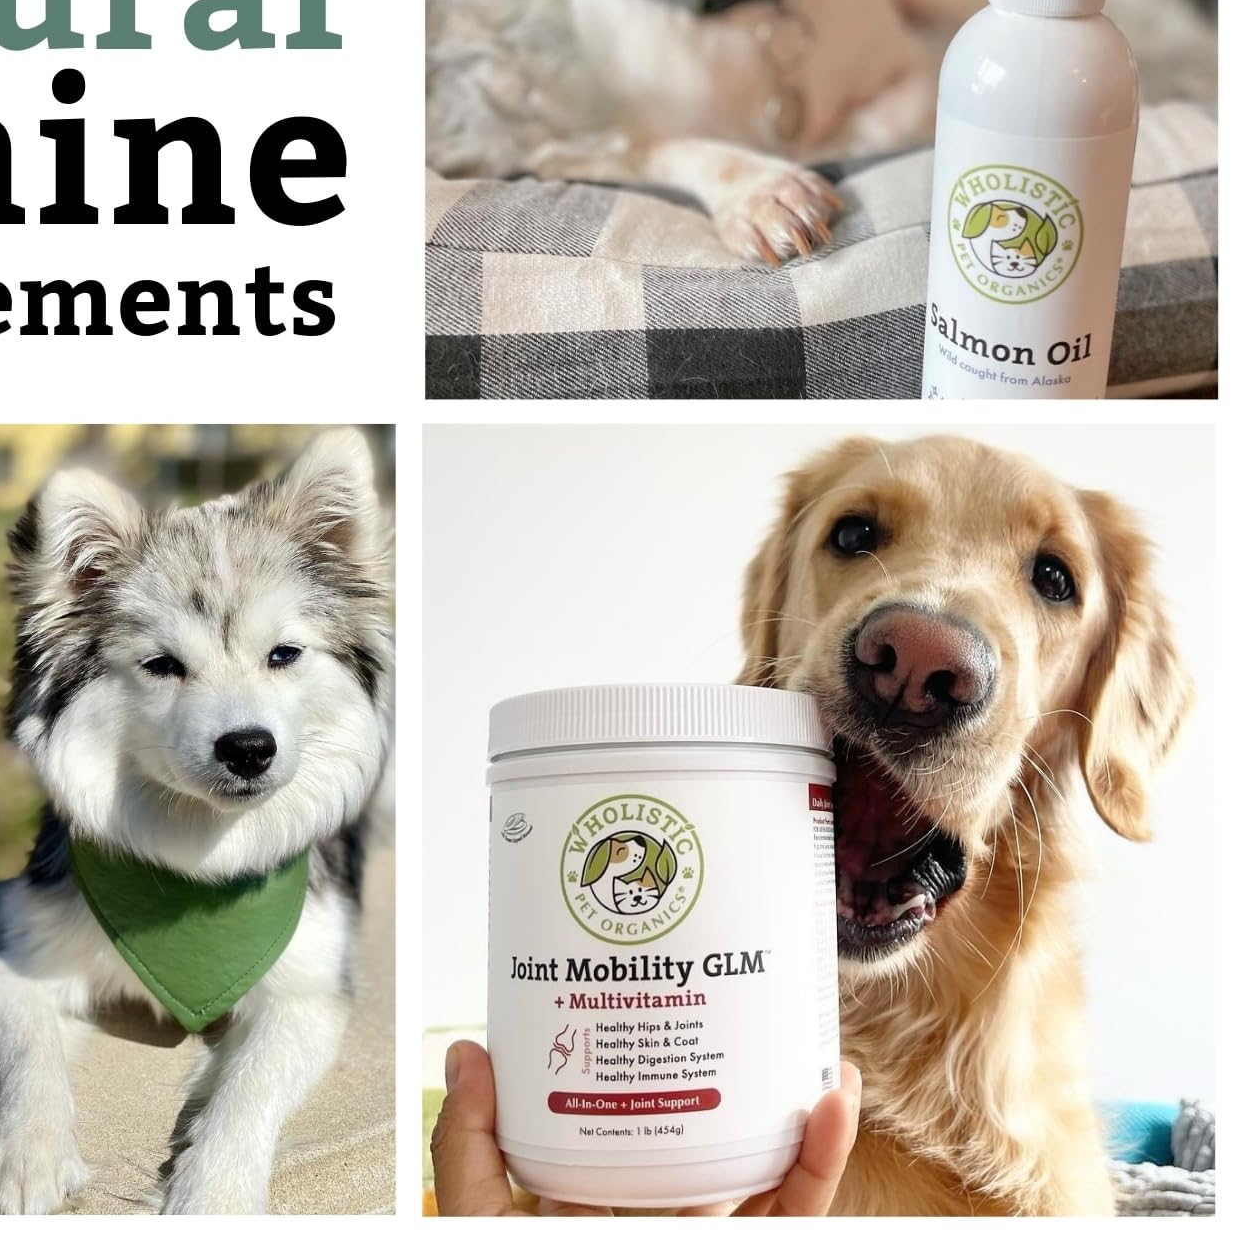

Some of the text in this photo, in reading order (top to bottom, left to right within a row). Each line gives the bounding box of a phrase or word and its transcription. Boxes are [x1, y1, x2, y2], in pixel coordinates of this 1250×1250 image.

[955, 173, 1076, 229] WHOLISTIC
[957, 242, 975, 270] PET
[931, 303, 1091, 365] Salmon Oil
[938, 343, 1071, 386] Wild caught from Alaska
[568, 803, 692, 856] WHOLISTIC
[575, 893, 598, 920] PET
[511, 957, 558, 982] Joint
[565, 956, 693, 986] Mobility
[554, 991, 707, 1009] + Multivitamin
[596, 1020, 703, 1034] Healthy Hips & Joints
[582, 1028, 593, 1075] Supports
[596, 1036, 698, 1052] Healthy Skin & Coat
[596, 1052, 724, 1068] Healthy Digestion System
[596, 1069, 716, 1084] Healthy Immune System
[566, 1098, 617, 1109] All-In-One
[630, 1099, 655, 1110] Joint
[659, 1096, 700, 1109] Support
[580, 1124, 684, 1136] Net Contents: 1 lb (454g)
